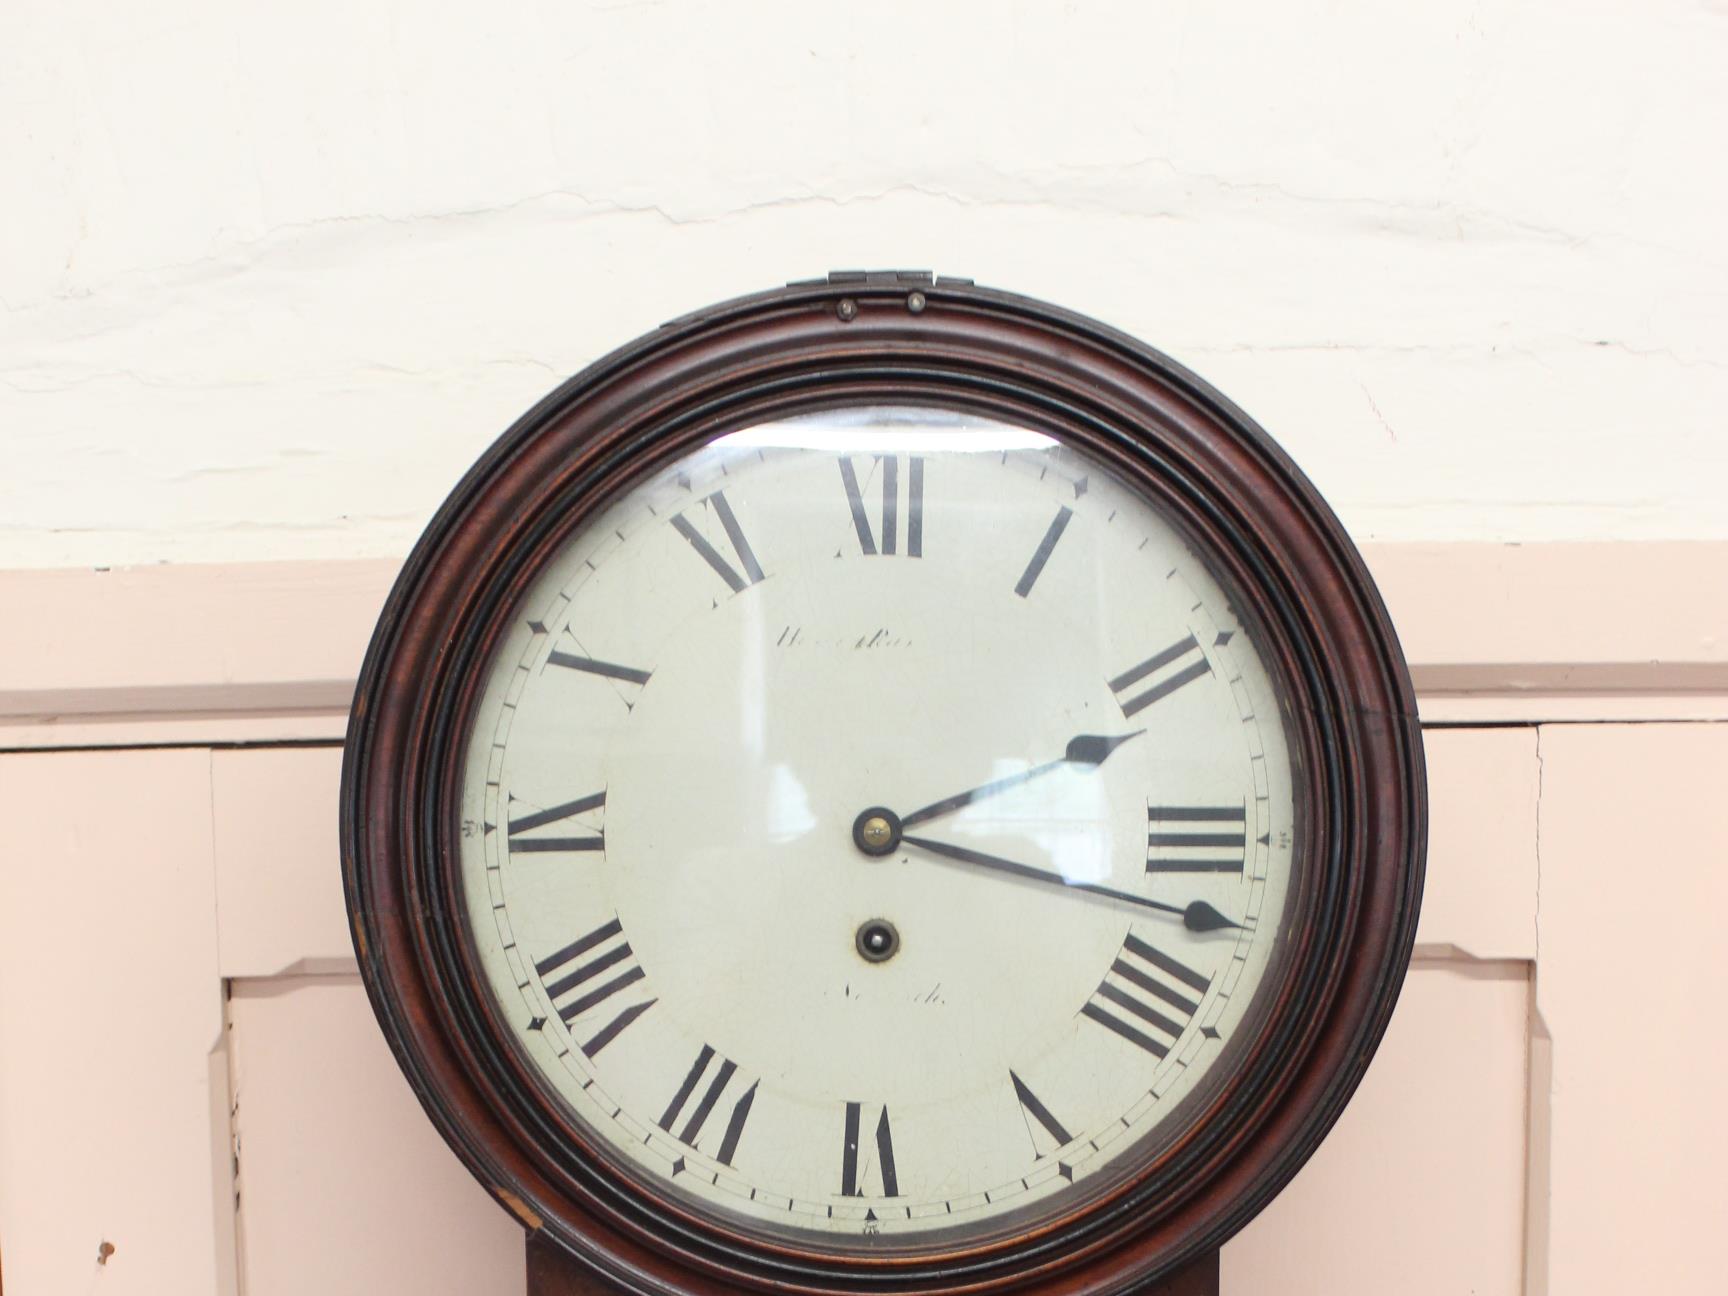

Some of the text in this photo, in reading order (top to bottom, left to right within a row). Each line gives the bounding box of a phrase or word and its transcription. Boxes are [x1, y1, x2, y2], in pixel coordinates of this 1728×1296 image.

[665, 488, 768, 609] XI
[833, 453, 925, 558] XII
[543, 622, 656, 714] X
[1106, 628, 1214, 719] II
[508, 786, 607, 862] IX
[1145, 799, 1246, 879] III
[531, 912, 659, 1065] VIII
[1075, 925, 1215, 1072] IIII
[653, 1043, 761, 1170] VII
[1010, 1067, 1081, 1160] V
